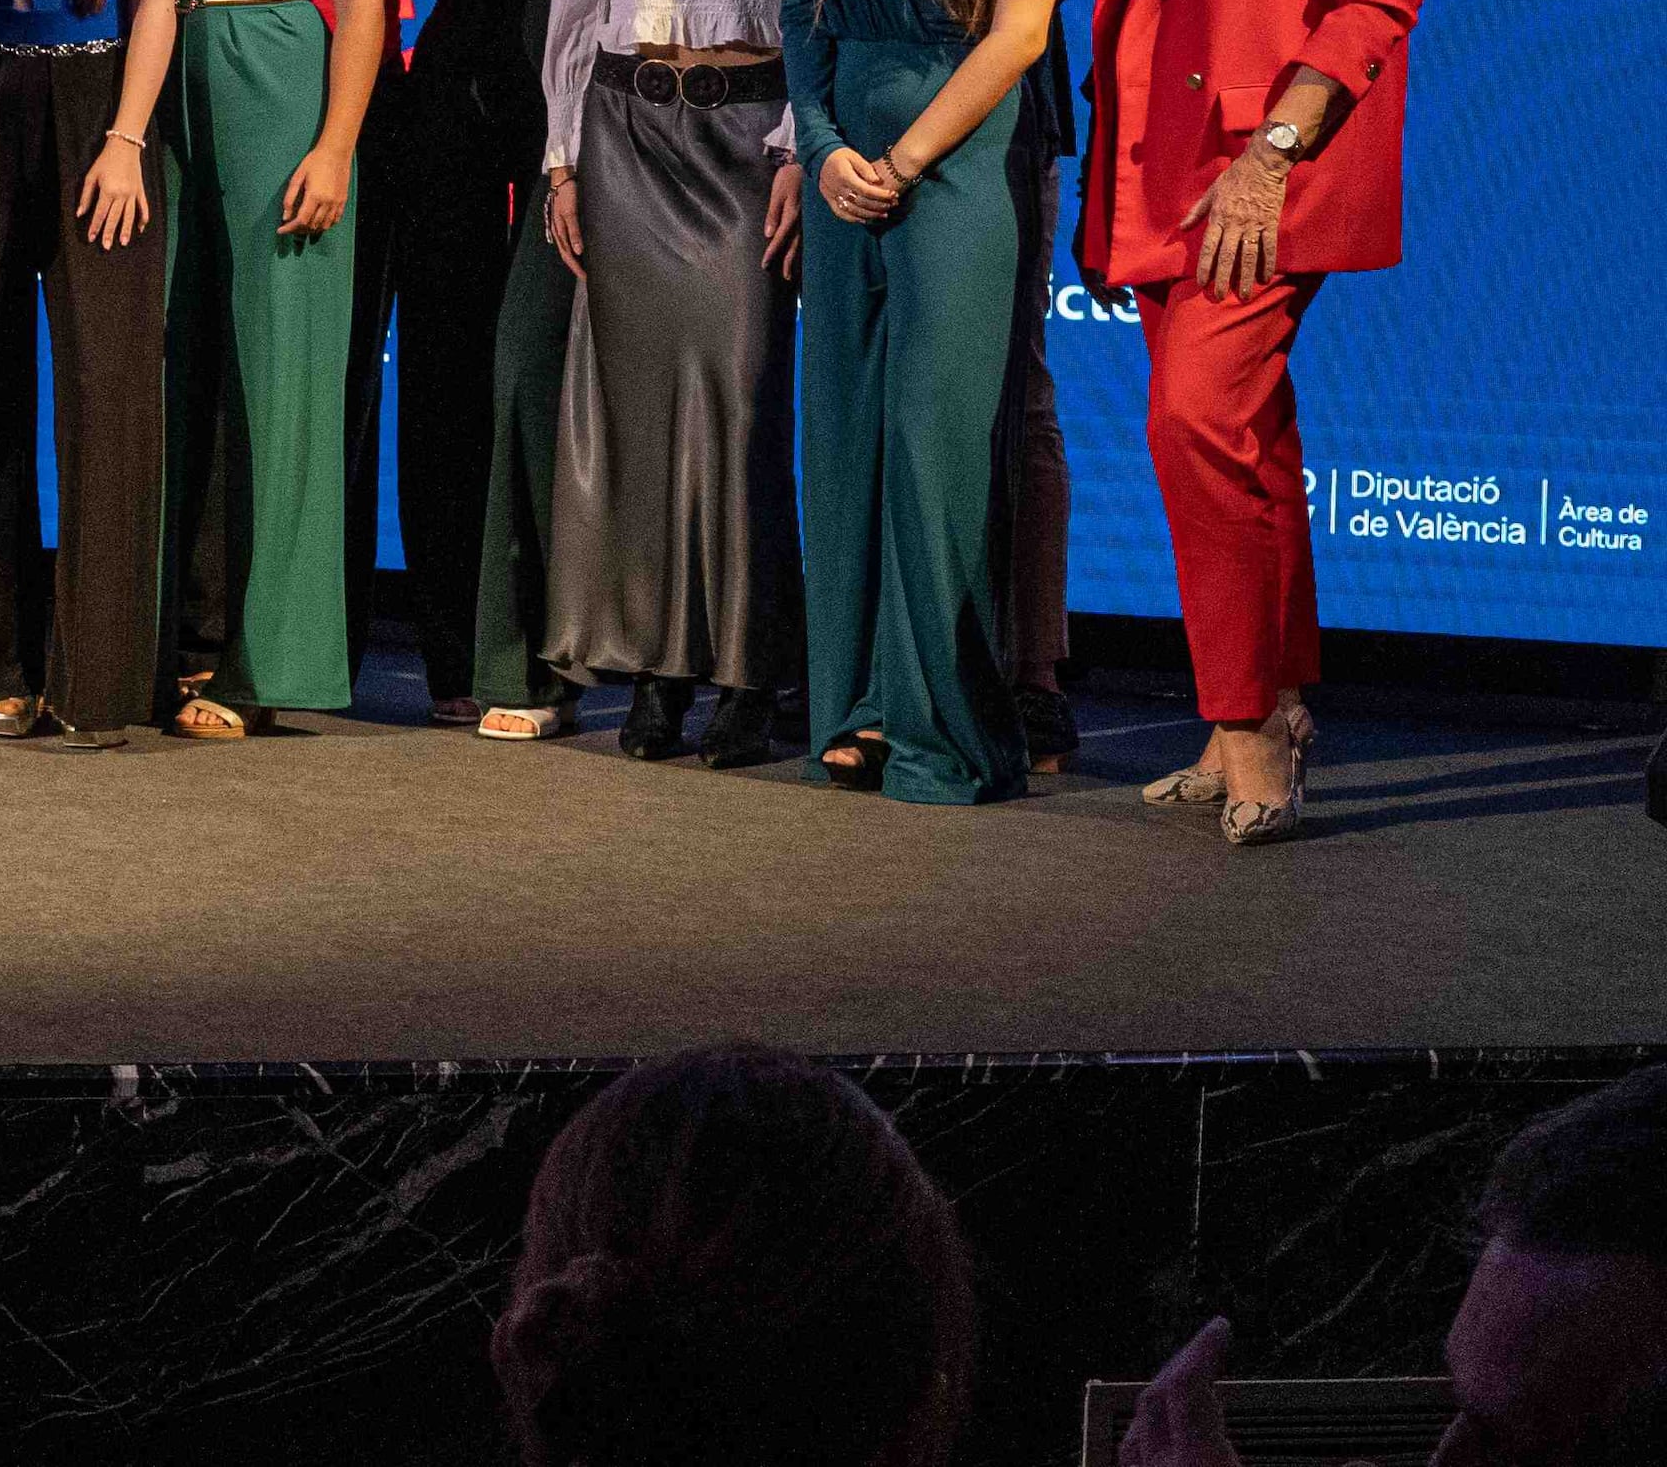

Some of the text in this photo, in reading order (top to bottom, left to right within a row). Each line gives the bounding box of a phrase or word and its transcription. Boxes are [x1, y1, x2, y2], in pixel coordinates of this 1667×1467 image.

[1350, 469, 1501, 506] Diputació
[1557, 495, 1649, 525] Àrea de
[1349, 509, 1527, 544] de València
[1557, 526, 1642, 551] Cultura
